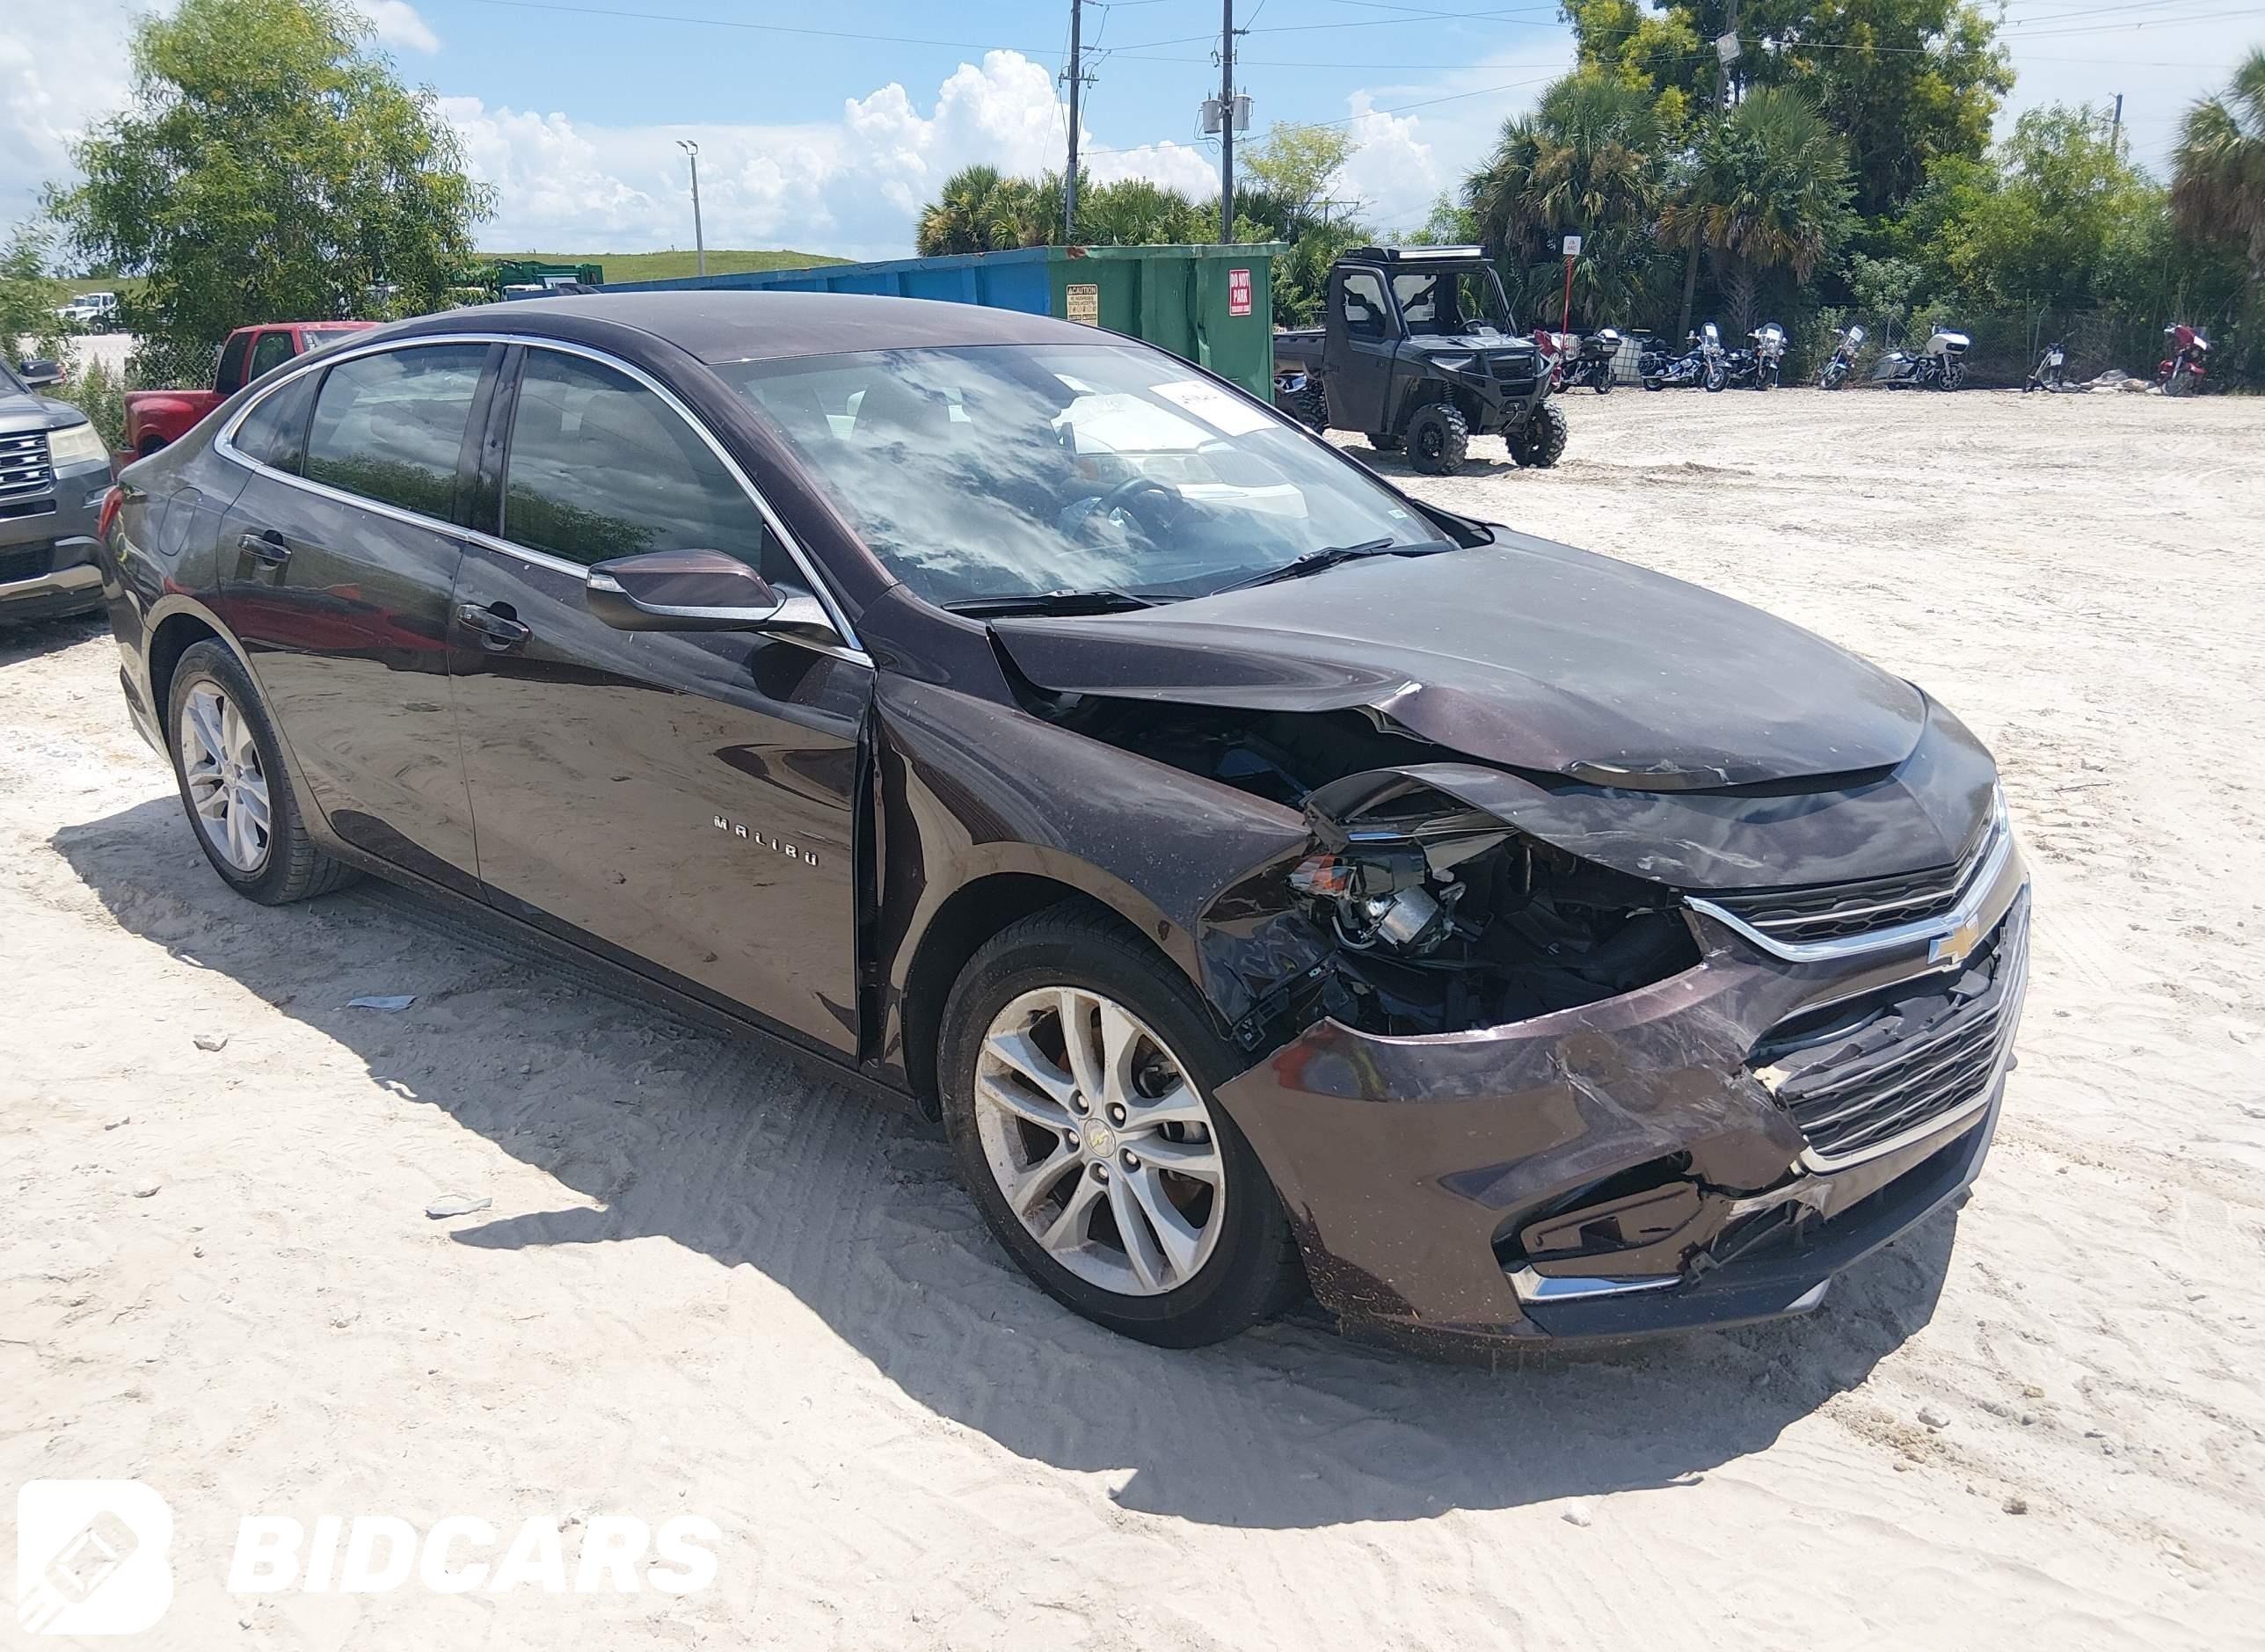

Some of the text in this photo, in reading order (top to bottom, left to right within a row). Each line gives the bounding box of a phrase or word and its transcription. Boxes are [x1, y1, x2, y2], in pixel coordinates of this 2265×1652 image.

[1230, 273, 1249, 287] DO NOT
[1072, 286, 1096, 295] CAUTION
[1233, 288, 1248, 303] PARK
[714, 814, 819, 866] MALIBU
